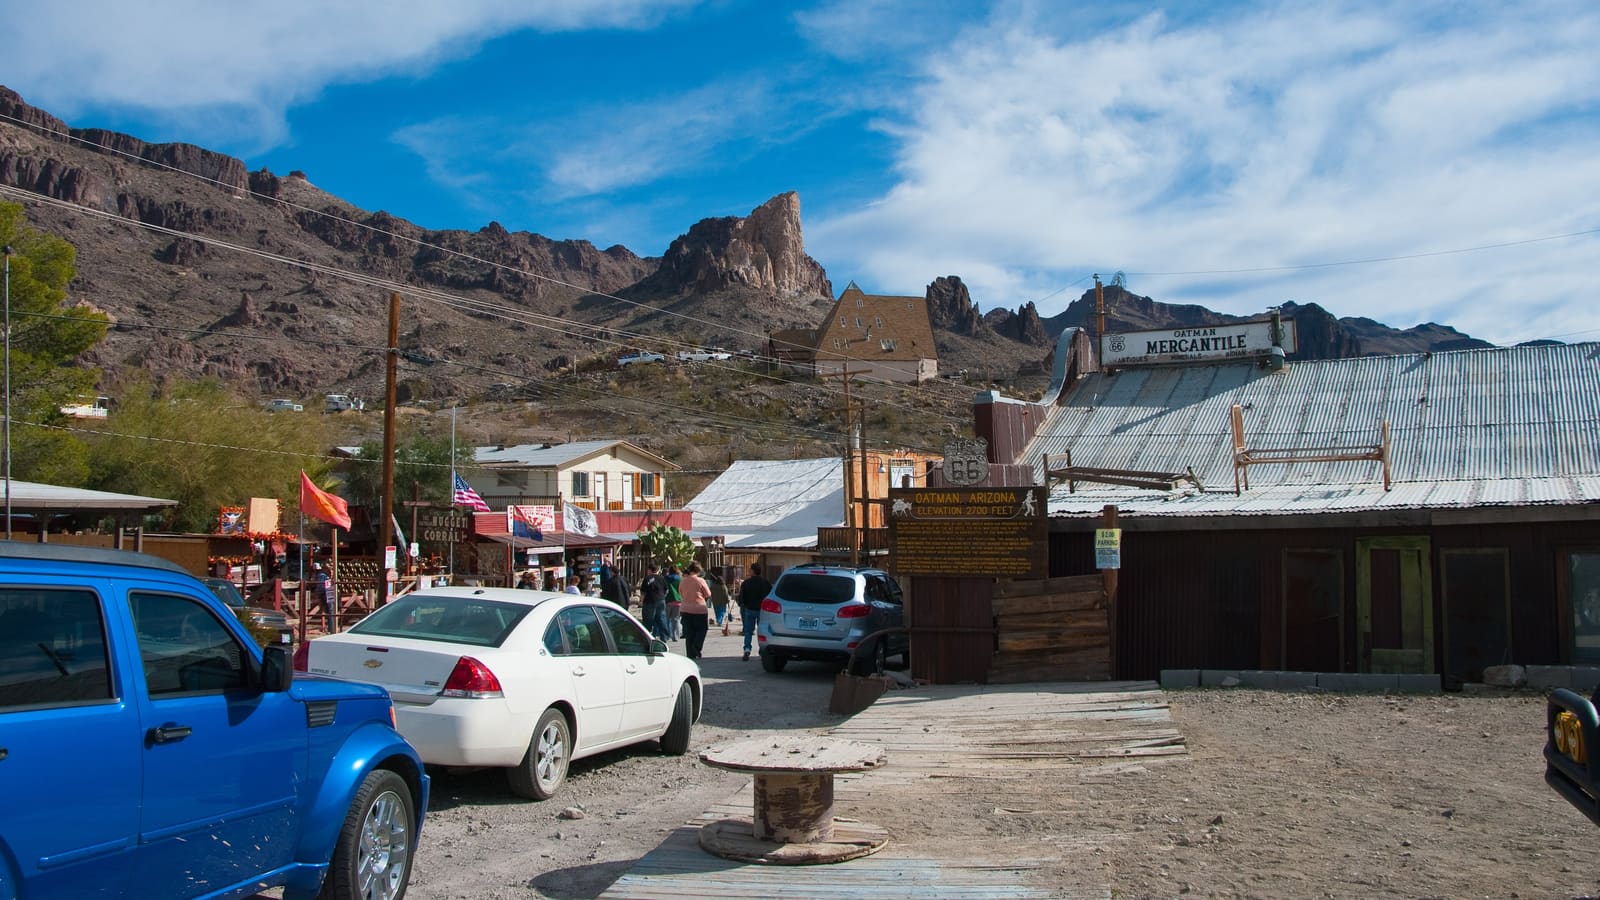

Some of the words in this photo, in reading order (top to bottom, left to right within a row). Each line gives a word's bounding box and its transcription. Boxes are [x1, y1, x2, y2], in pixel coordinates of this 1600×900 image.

[1173, 328, 1216, 338] OATMAN
[1111, 342, 1123, 351] 66
[1146, 335, 1247, 355] MERCANTILE
[951, 459, 980, 480] 66
[969, 492, 1016, 504] ARIZONA
[917, 506, 962, 515] ELEVATION
[991, 505, 1014, 515] FEET
[432, 516, 467, 529] NUGGET
[424, 530, 460, 543] CORRAL
[1097, 538, 1118, 546] PARKING
